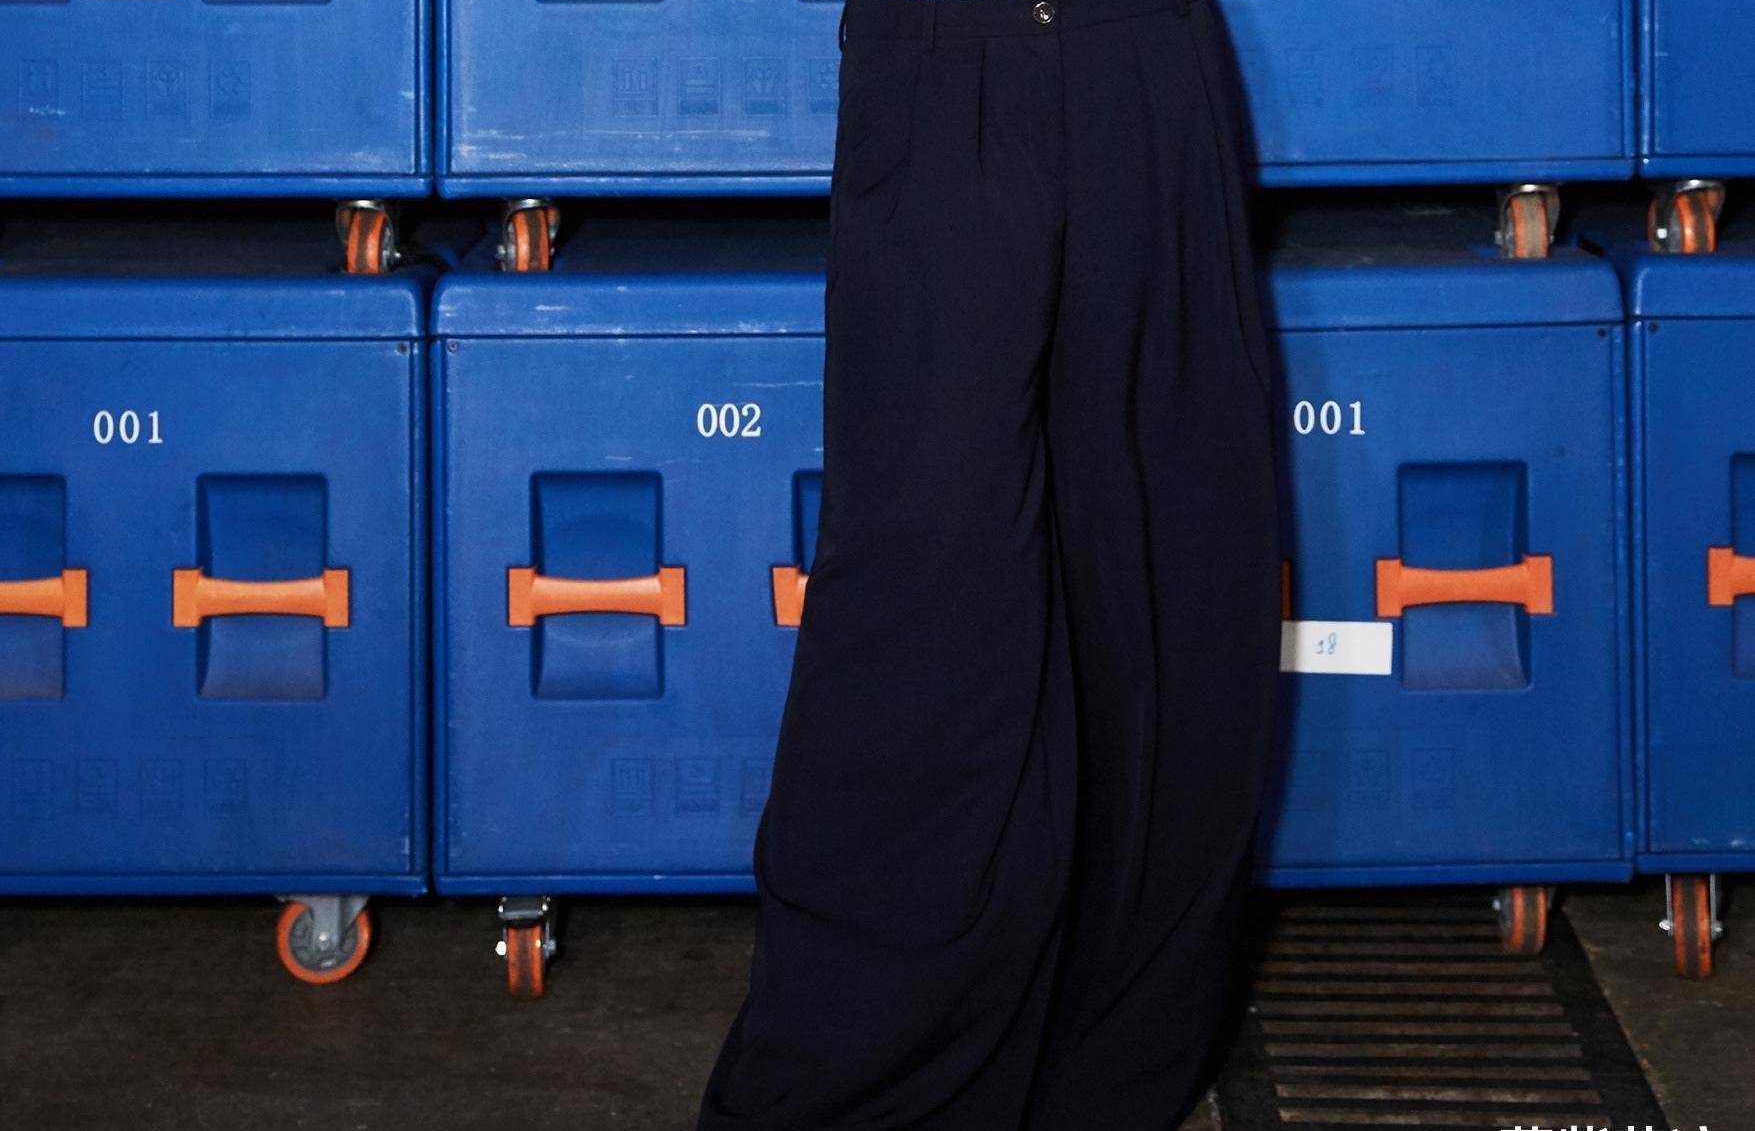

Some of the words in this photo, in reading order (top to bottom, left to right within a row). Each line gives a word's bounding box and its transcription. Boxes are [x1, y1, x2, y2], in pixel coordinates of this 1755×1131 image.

[93, 410, 163, 444] 001
[696, 403, 762, 438] 002
[1293, 400, 1366, 435] 001
